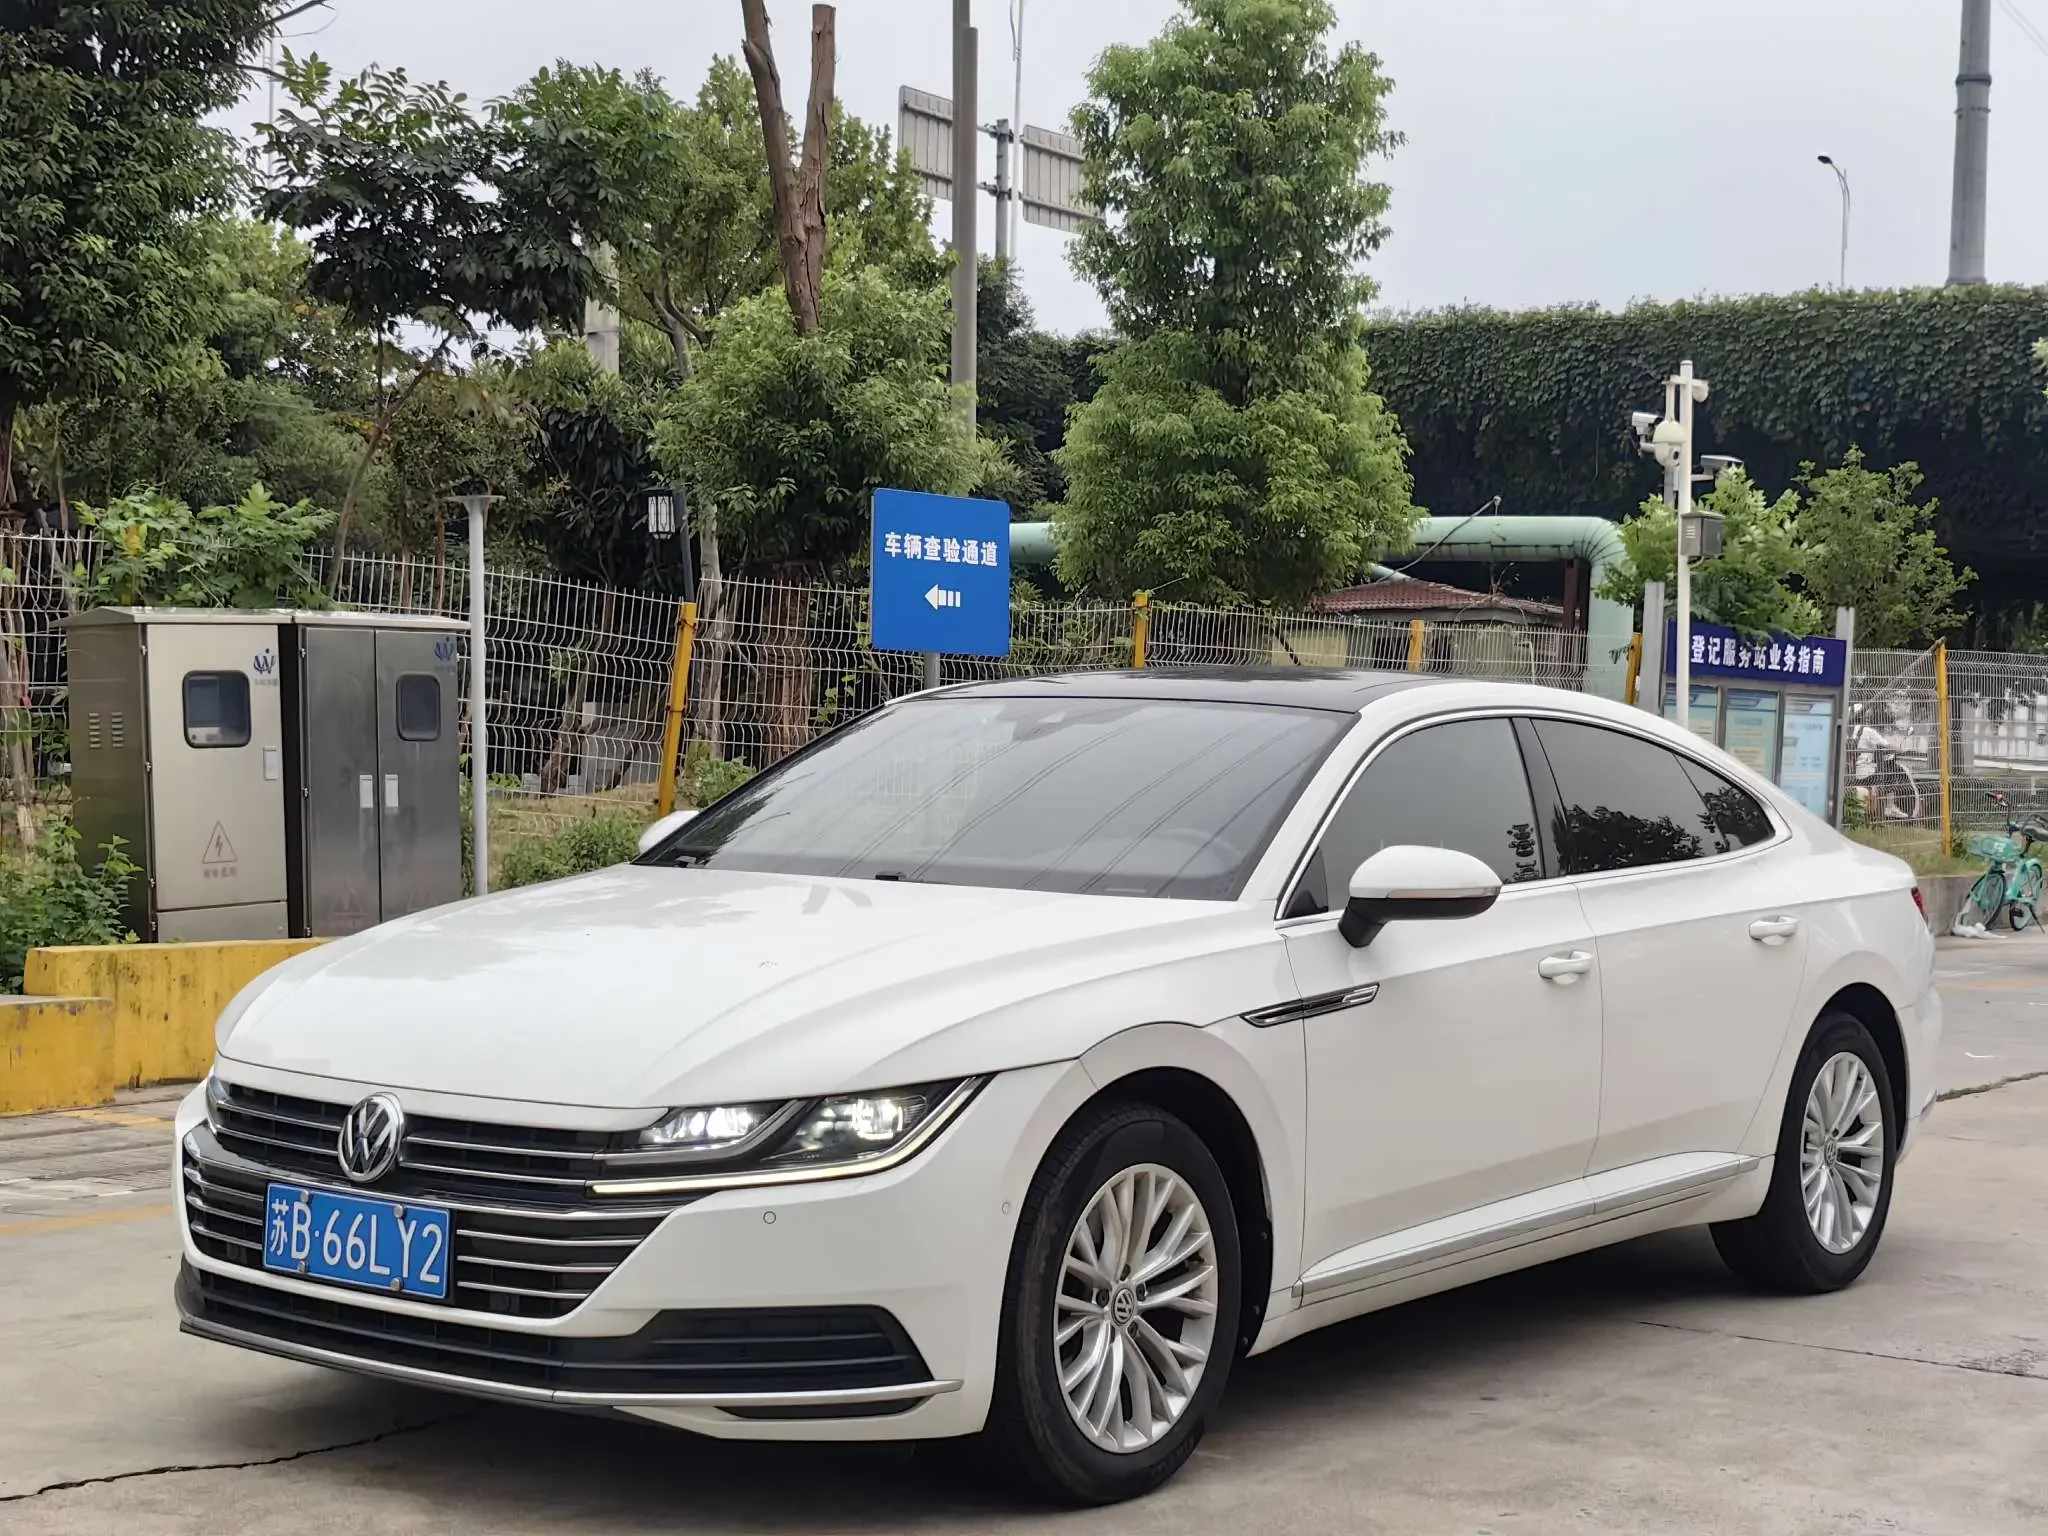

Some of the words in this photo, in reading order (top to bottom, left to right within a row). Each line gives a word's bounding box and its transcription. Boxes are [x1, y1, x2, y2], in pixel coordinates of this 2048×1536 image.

[884, 531, 998, 567] 车辆查验通道
[1691, 634, 1825, 675] 登记服务站业务指南
